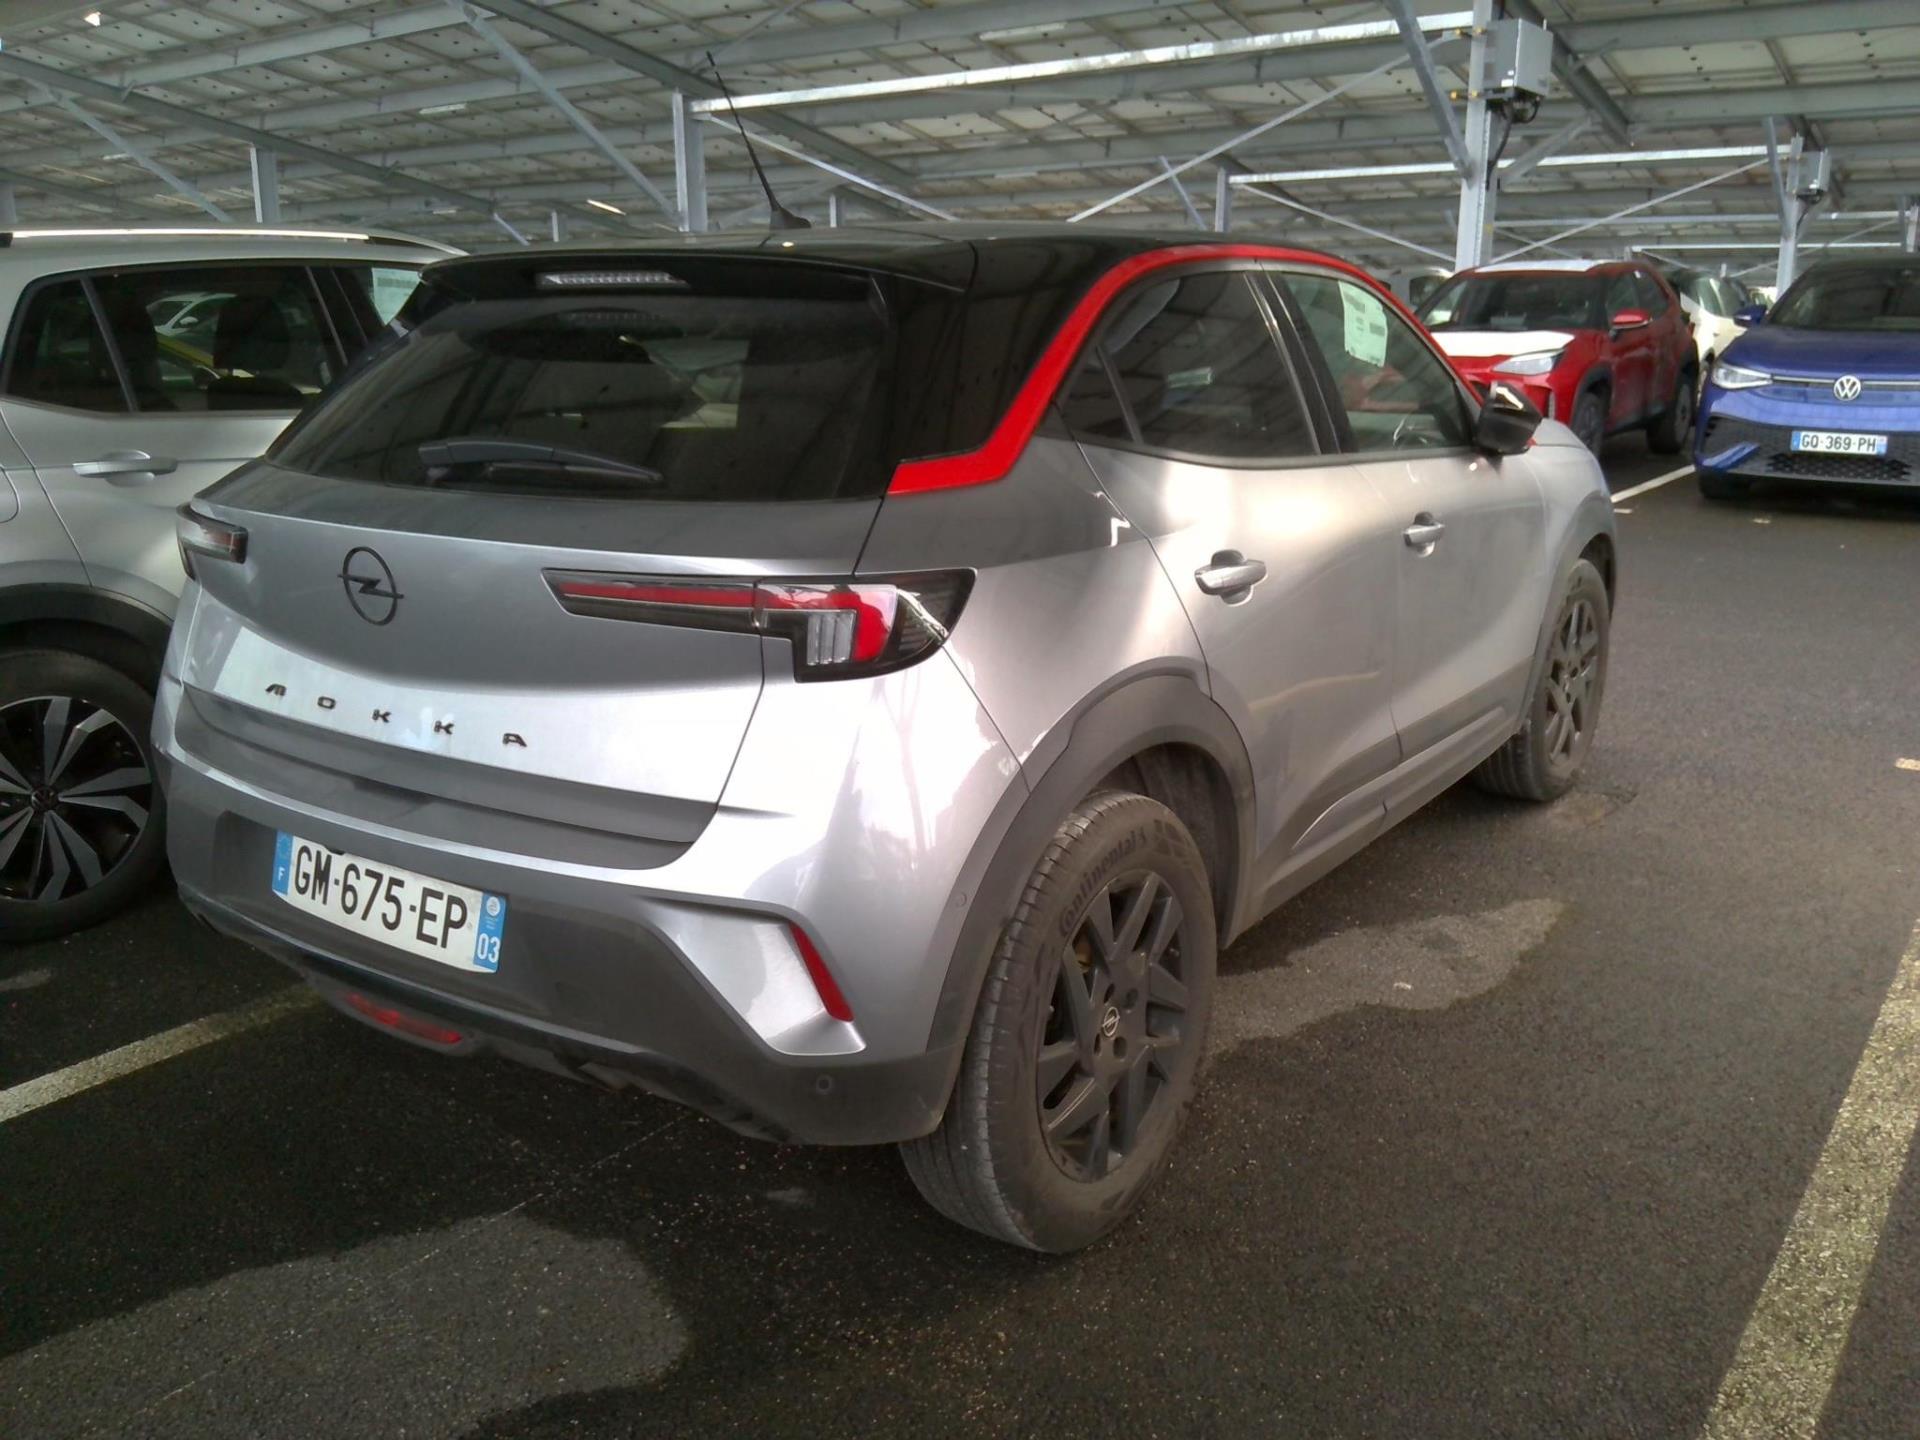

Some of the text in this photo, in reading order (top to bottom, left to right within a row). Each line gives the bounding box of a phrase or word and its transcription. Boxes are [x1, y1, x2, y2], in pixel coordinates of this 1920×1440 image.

[264, 683, 528, 748] MOKKA
[277, 867, 285, 881] F
[294, 845, 468, 949] GM-675-EP
[1058, 828, 1138, 937] Continental
[477, 933, 501, 963] 03
